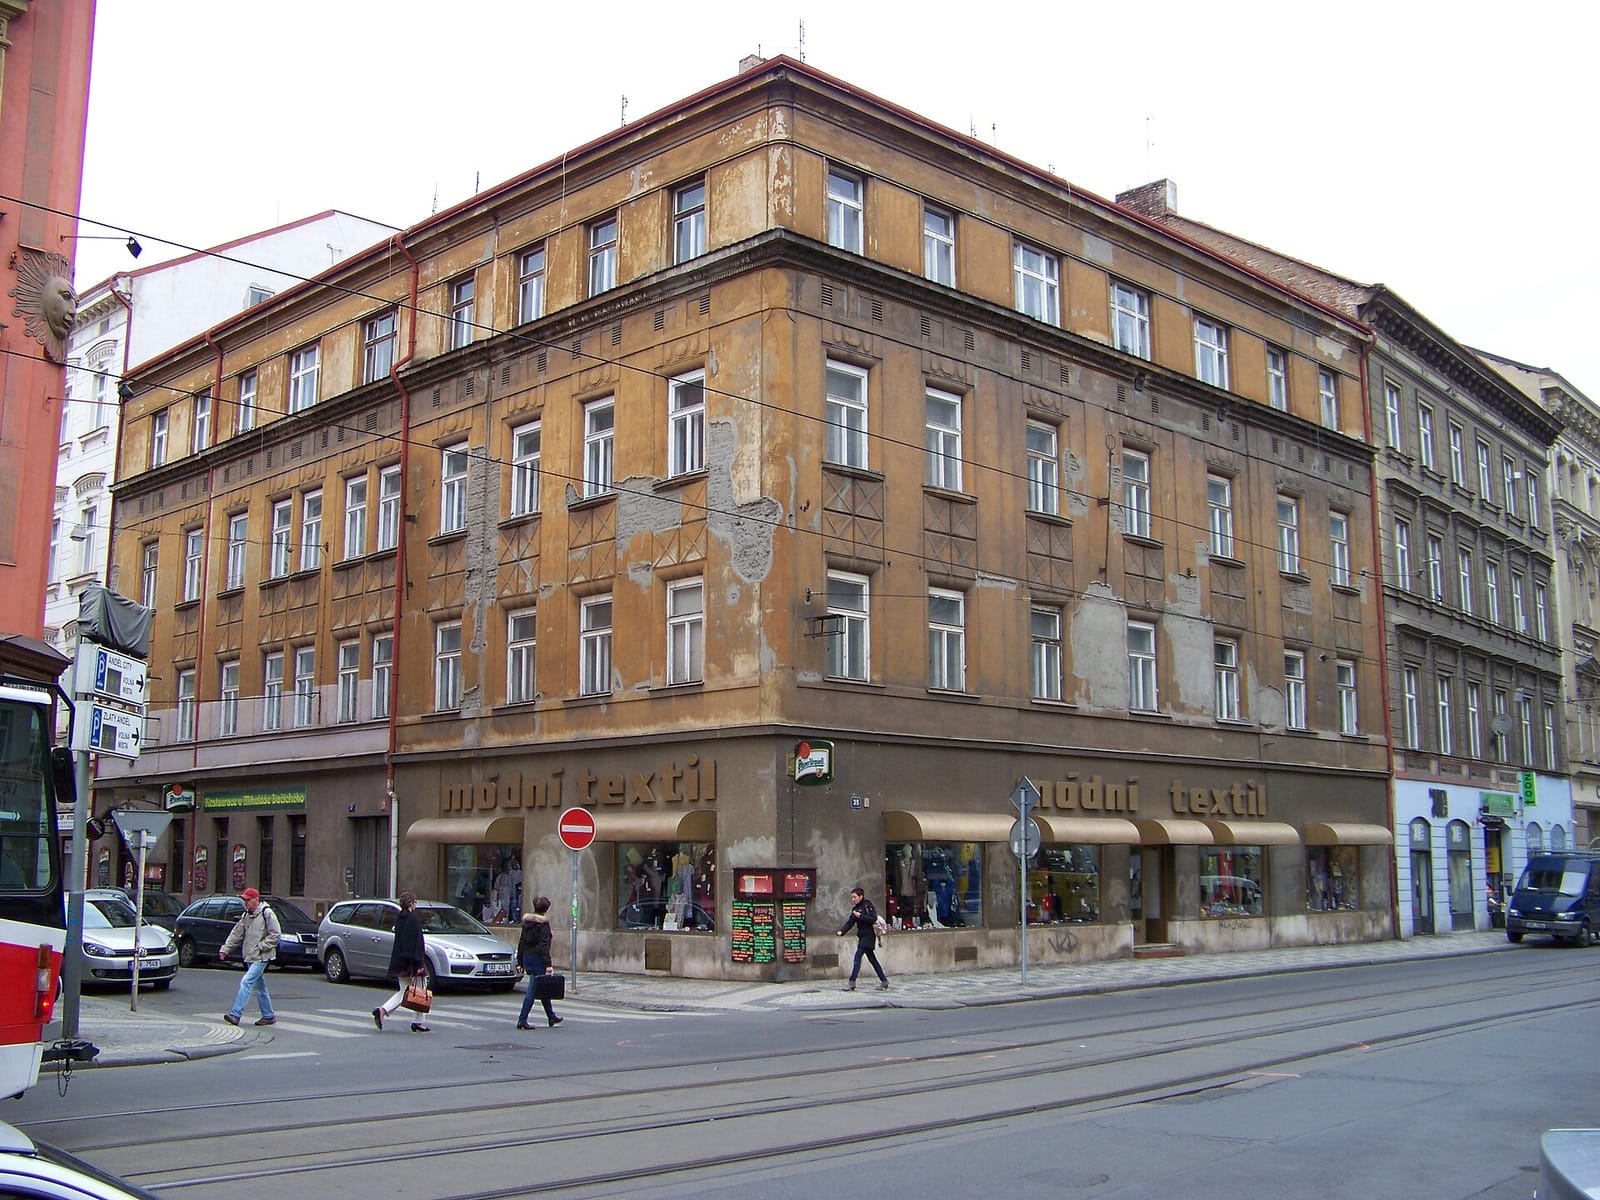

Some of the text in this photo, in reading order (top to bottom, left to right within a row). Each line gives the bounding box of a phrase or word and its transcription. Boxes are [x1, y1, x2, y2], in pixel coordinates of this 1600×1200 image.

[443, 754, 717, 811] módní textil
[1171, 779, 1267, 816] textil
